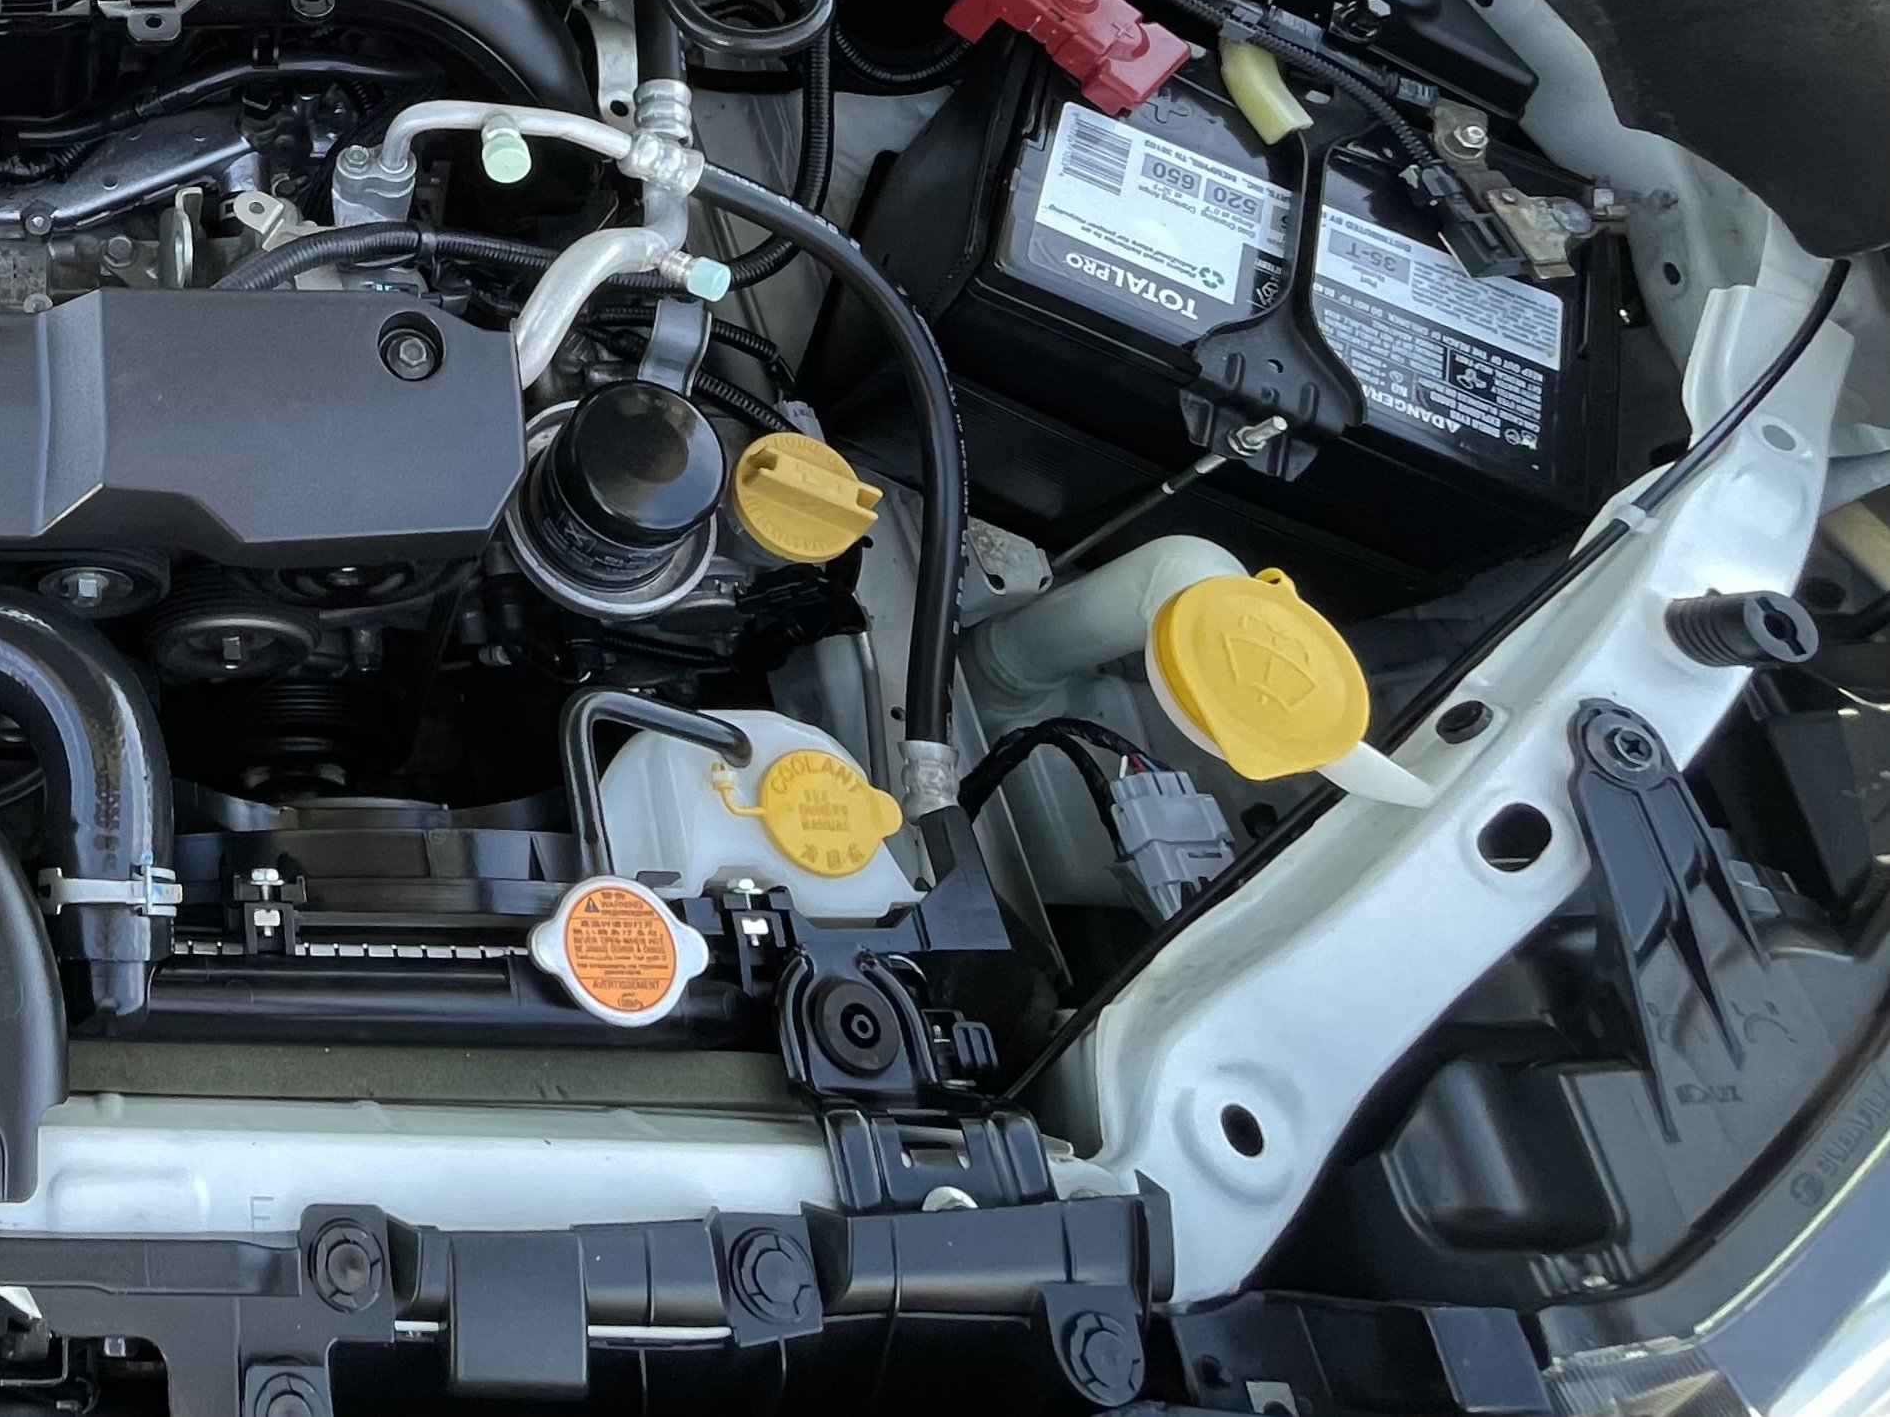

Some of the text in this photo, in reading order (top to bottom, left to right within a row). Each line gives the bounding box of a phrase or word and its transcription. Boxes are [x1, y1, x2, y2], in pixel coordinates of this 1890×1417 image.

[1150, 160, 1195, 191] 650
[1210, 184, 1257, 216] 520
[1346, 240, 1398, 274] 35-T
[1063, 251, 1199, 320] TOTALPRO
[1390, 380, 1408, 398] NO
[770, 755, 865, 795] COOLANT
